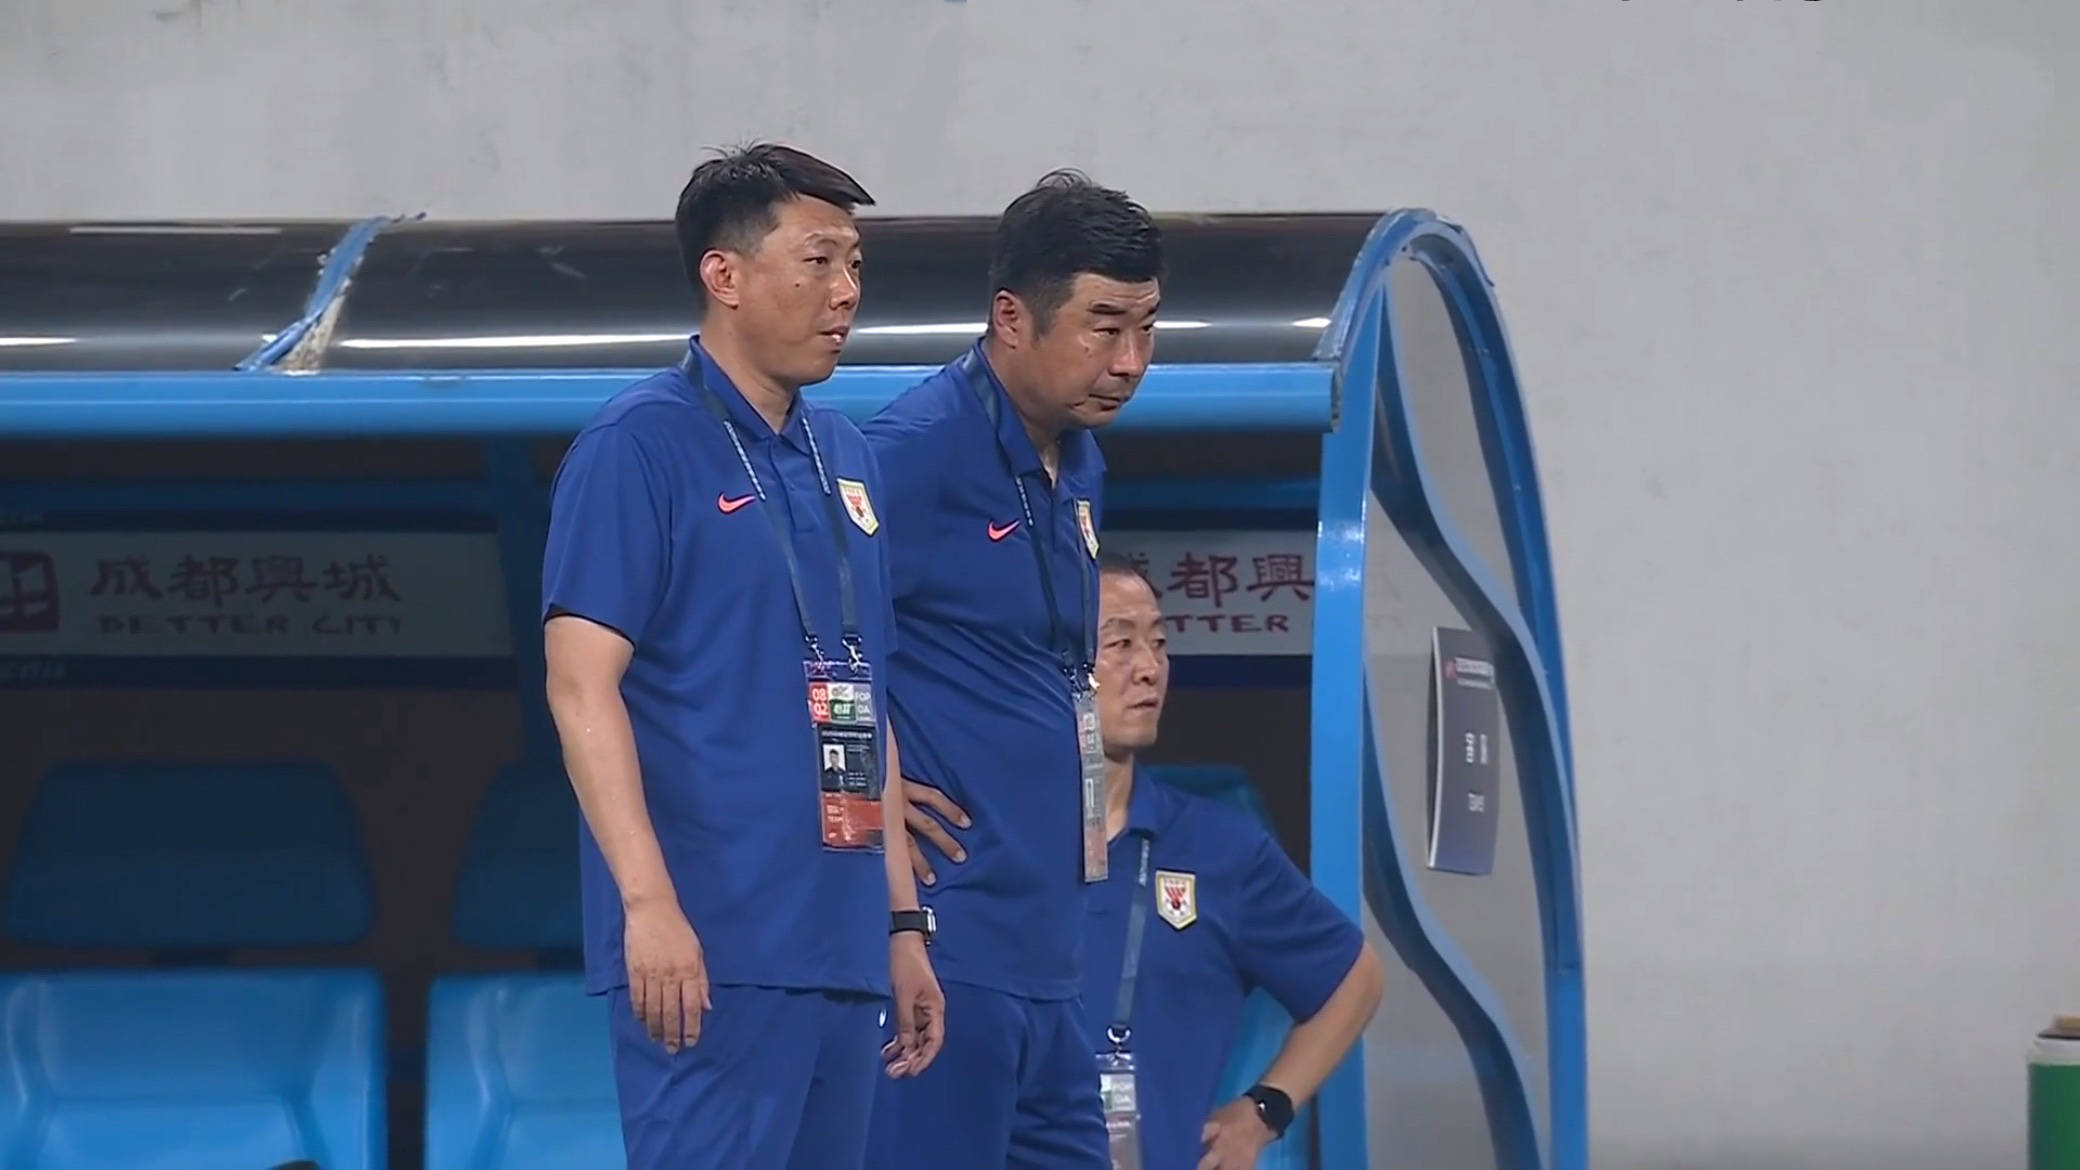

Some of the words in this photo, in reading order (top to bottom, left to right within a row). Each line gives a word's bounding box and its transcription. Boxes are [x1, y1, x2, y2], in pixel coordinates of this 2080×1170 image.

[99, 615, 289, 635] BETTER
[312, 615, 403, 635] CITY
[1165, 614, 1289, 633] TTER
